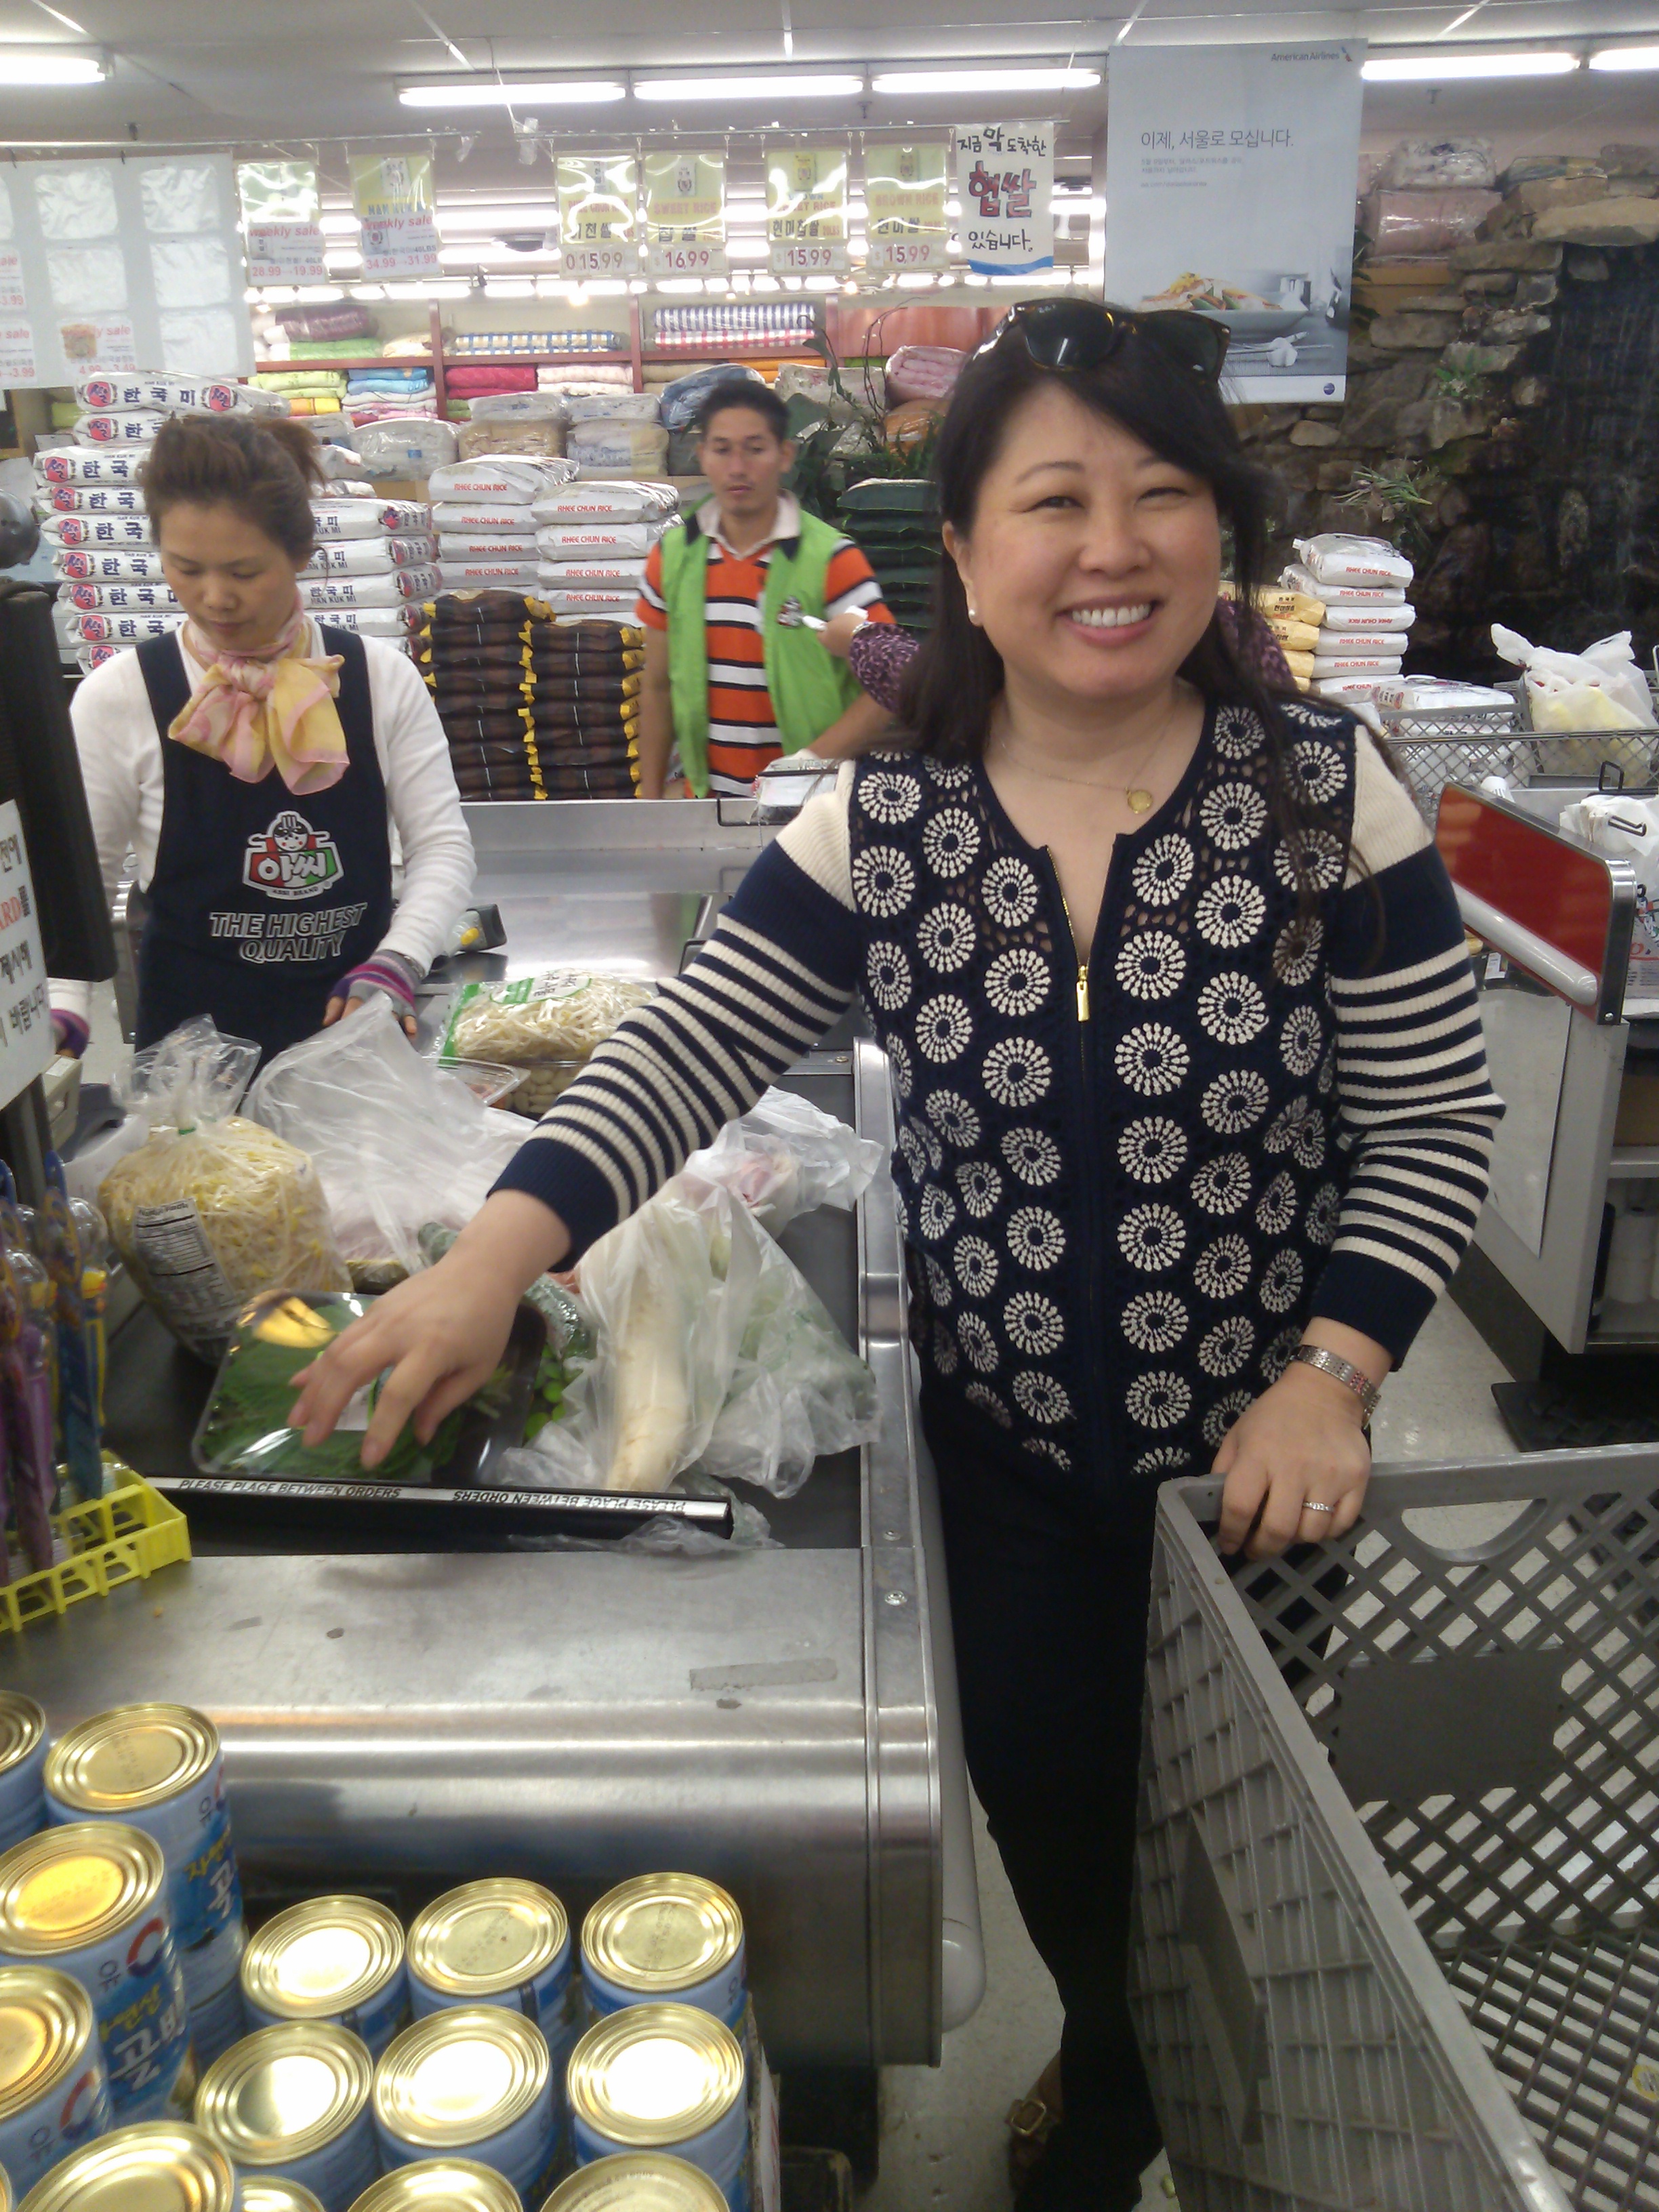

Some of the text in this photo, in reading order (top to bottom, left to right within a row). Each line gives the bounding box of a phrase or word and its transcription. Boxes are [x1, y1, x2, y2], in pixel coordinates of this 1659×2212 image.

[957, 126, 1046, 157] 지금 막 도착한
[1141, 127, 1294, 150] 이제, 서울로 모십니다.
[875, 192, 939, 206] BROWN RICE
[653, 201, 717, 215] SWEET RICE
[813, 201, 836, 211] RICE
[409, 216, 432, 226] sale
[249, 224, 320, 239] weekly sale
[968, 228, 1033, 252] 있습니다.
[366, 253, 437, 270] 34.99 31.99
[252, 266, 281, 276] 28.99
[5, 329, 30, 339] sale
[106, 326, 131, 335] sale
[606, 569, 620, 577] RICE
[310, 585, 354, 598] 한국미
[310, 594, 356, 605] HAN KUK MI
[349, 623, 359, 631] MI
[257, 852, 327, 882] 아씨
[293, 886, 319, 896] BRAND
[209, 902, 369, 938] THE HIGHEST
[239, 930, 347, 964] QUALITY
[180, 1480, 403, 1498] PLEASE PLACE BETWEEN ORDERS
[453, 1491, 508, 1502] ORDERS
[513, 1494, 580, 1507] BETWEEN
[585, 1496, 628, 1509] PLACE
